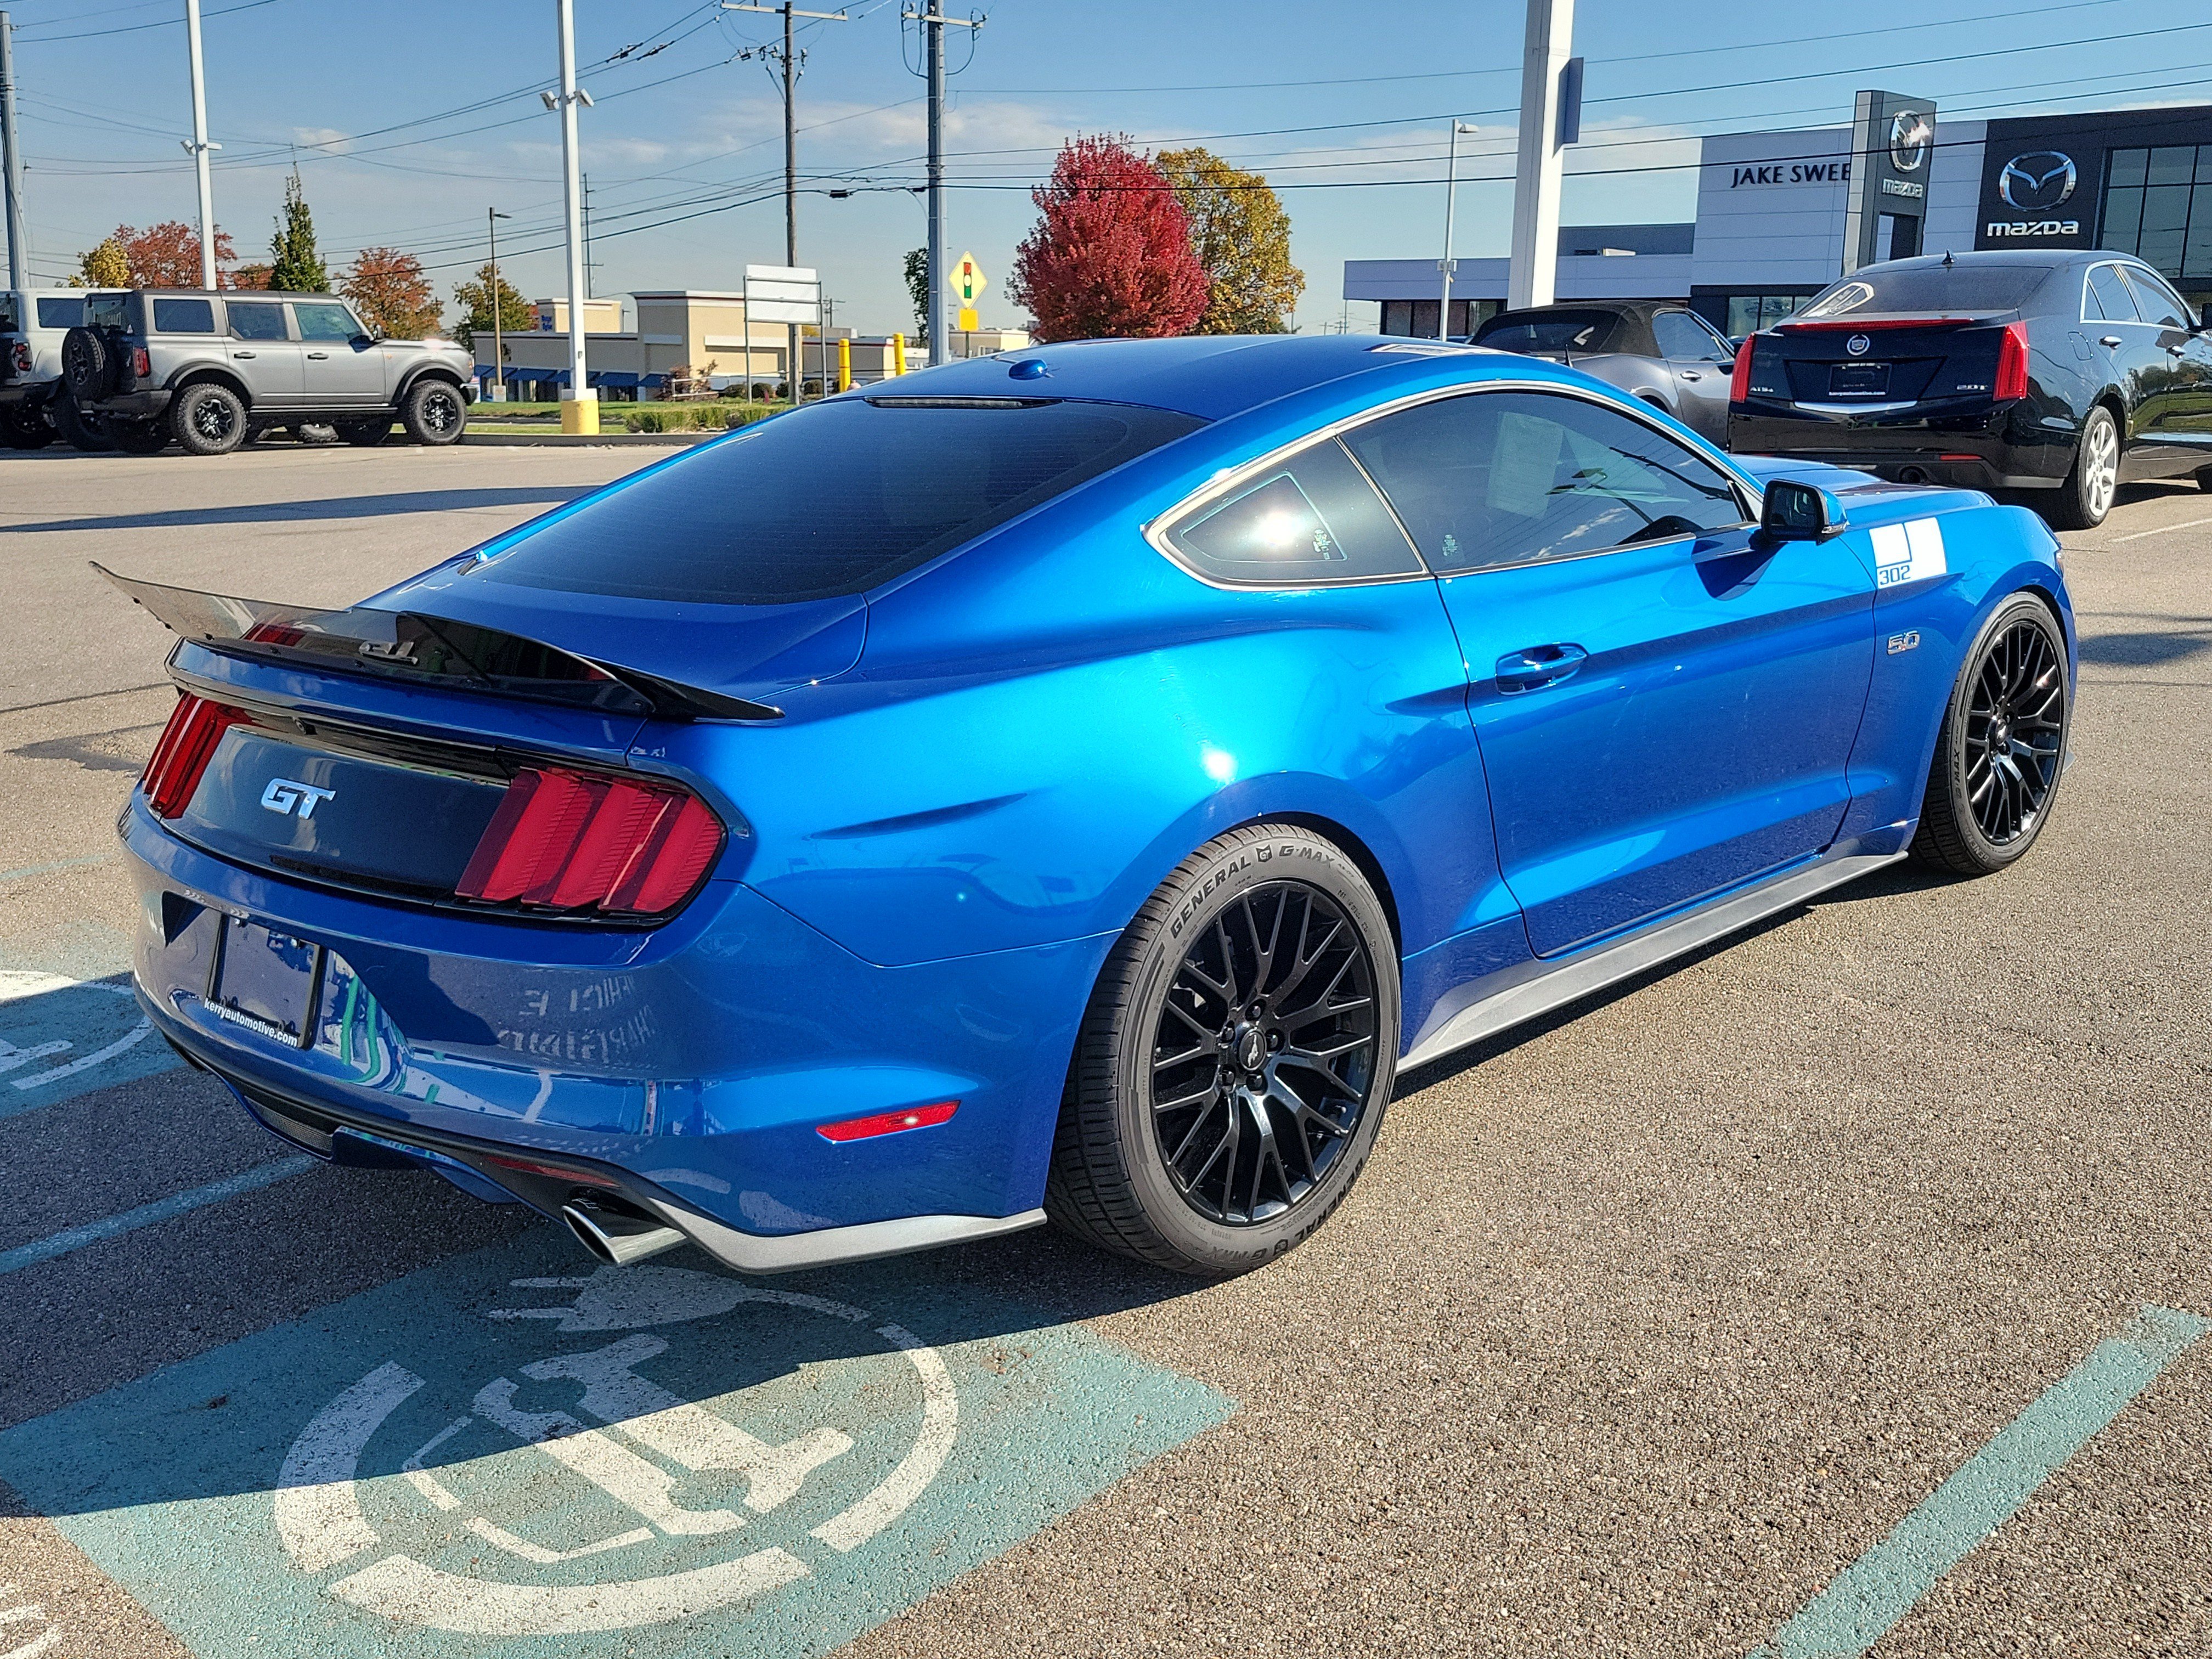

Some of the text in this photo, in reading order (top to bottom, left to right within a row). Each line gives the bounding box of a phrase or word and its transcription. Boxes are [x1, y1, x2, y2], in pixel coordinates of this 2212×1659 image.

[1730, 166, 1784, 188] JAKE
[1987, 221, 2080, 237] mazda
[1880, 565, 1911, 585] 302
[260, 778, 336, 820] GT
[1170, 856, 1251, 939] GENERAL
[204, 997, 298, 1047] kerryautomotive.com
